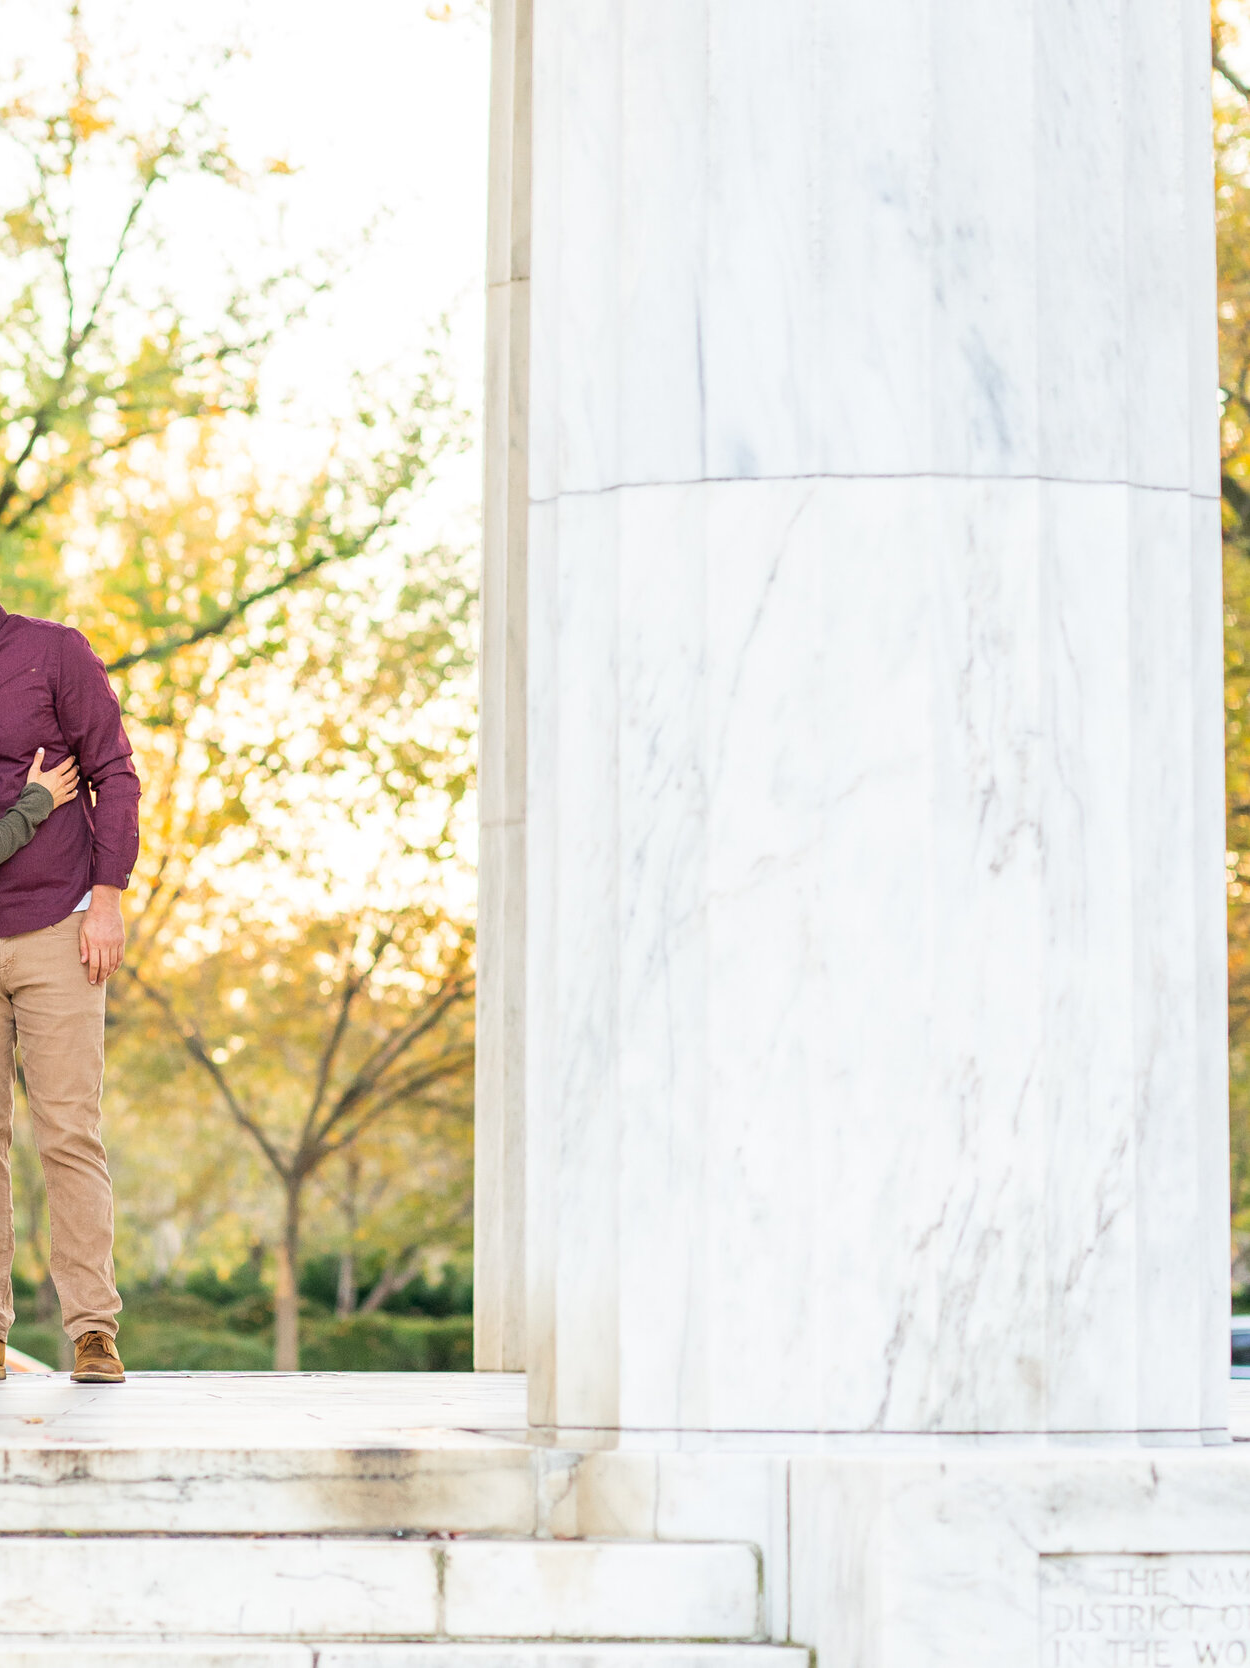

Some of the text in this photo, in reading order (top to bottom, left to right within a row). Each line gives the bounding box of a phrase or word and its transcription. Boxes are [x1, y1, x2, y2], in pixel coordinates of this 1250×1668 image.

[1107, 1568, 1169, 1596] THE
[1052, 1603, 1250, 1632] DISTRICT O
[1053, 1638, 1088, 1667] IN
[1106, 1638, 1173, 1668] THE
